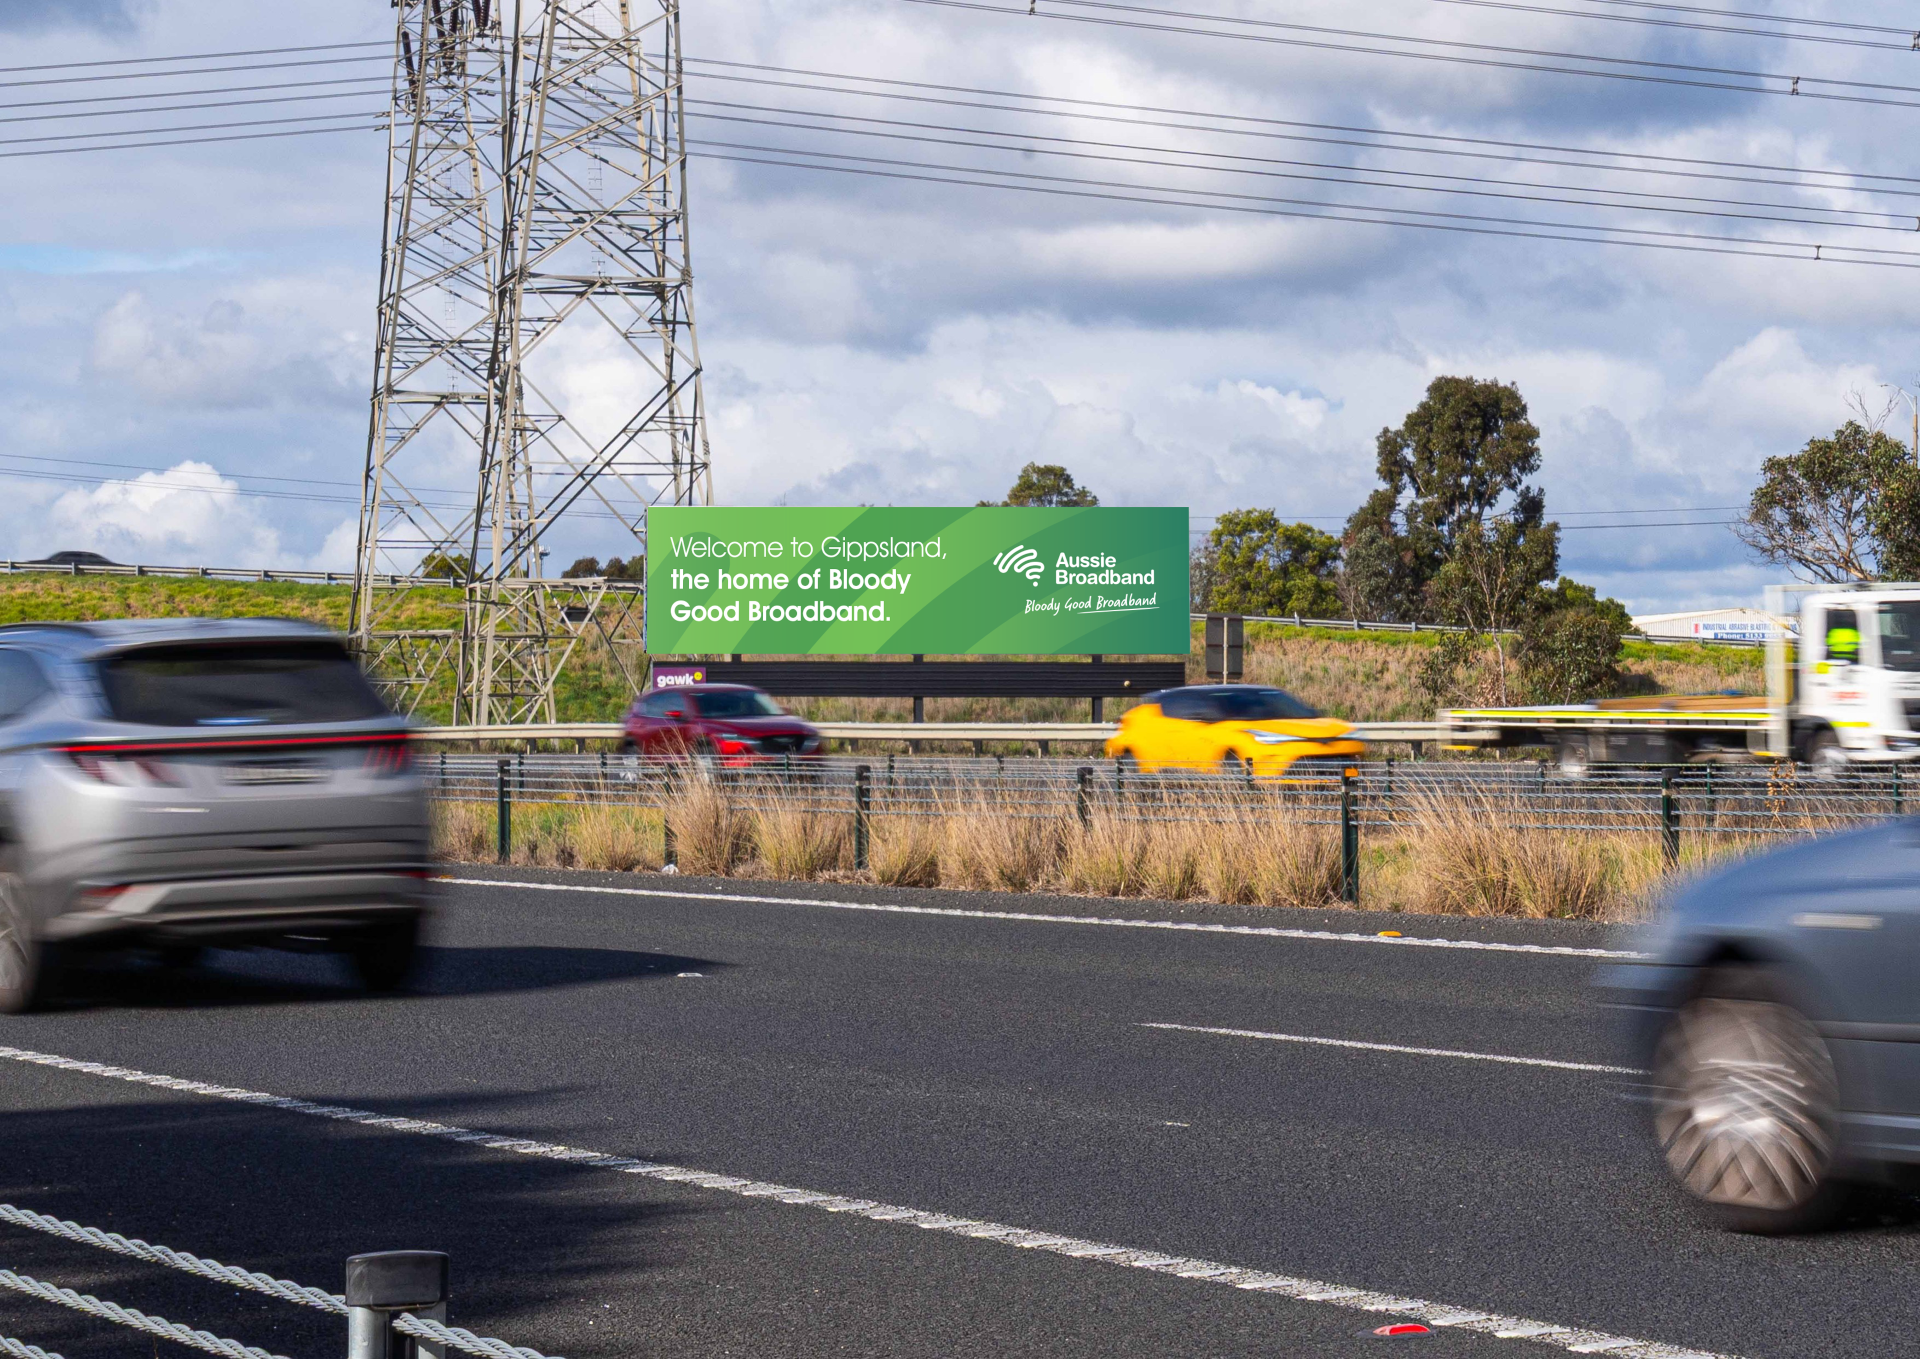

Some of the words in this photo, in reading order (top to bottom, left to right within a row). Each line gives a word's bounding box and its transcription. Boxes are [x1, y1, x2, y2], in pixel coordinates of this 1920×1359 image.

[669, 536, 784, 558] Welcome
[790, 536, 814, 558] to
[821, 536, 947, 562] Gippsland,
[1055, 552, 1117, 568] Aussie
[670, 568, 710, 590] the
[718, 568, 790, 590] home
[797, 567, 821, 590] of
[829, 568, 912, 595] Bloody
[1055, 569, 1155, 585] Broadband
[670, 600, 740, 622] Good
[748, 600, 891, 622] Broadband.
[1024, 598, 1060, 617] Bloody
[1064, 595, 1092, 612] Good
[1096, 592, 1157, 611] Broadband
[1702, 623, 1727, 631] INDUSTRIAL
[656, 673, 695, 688] gawk
